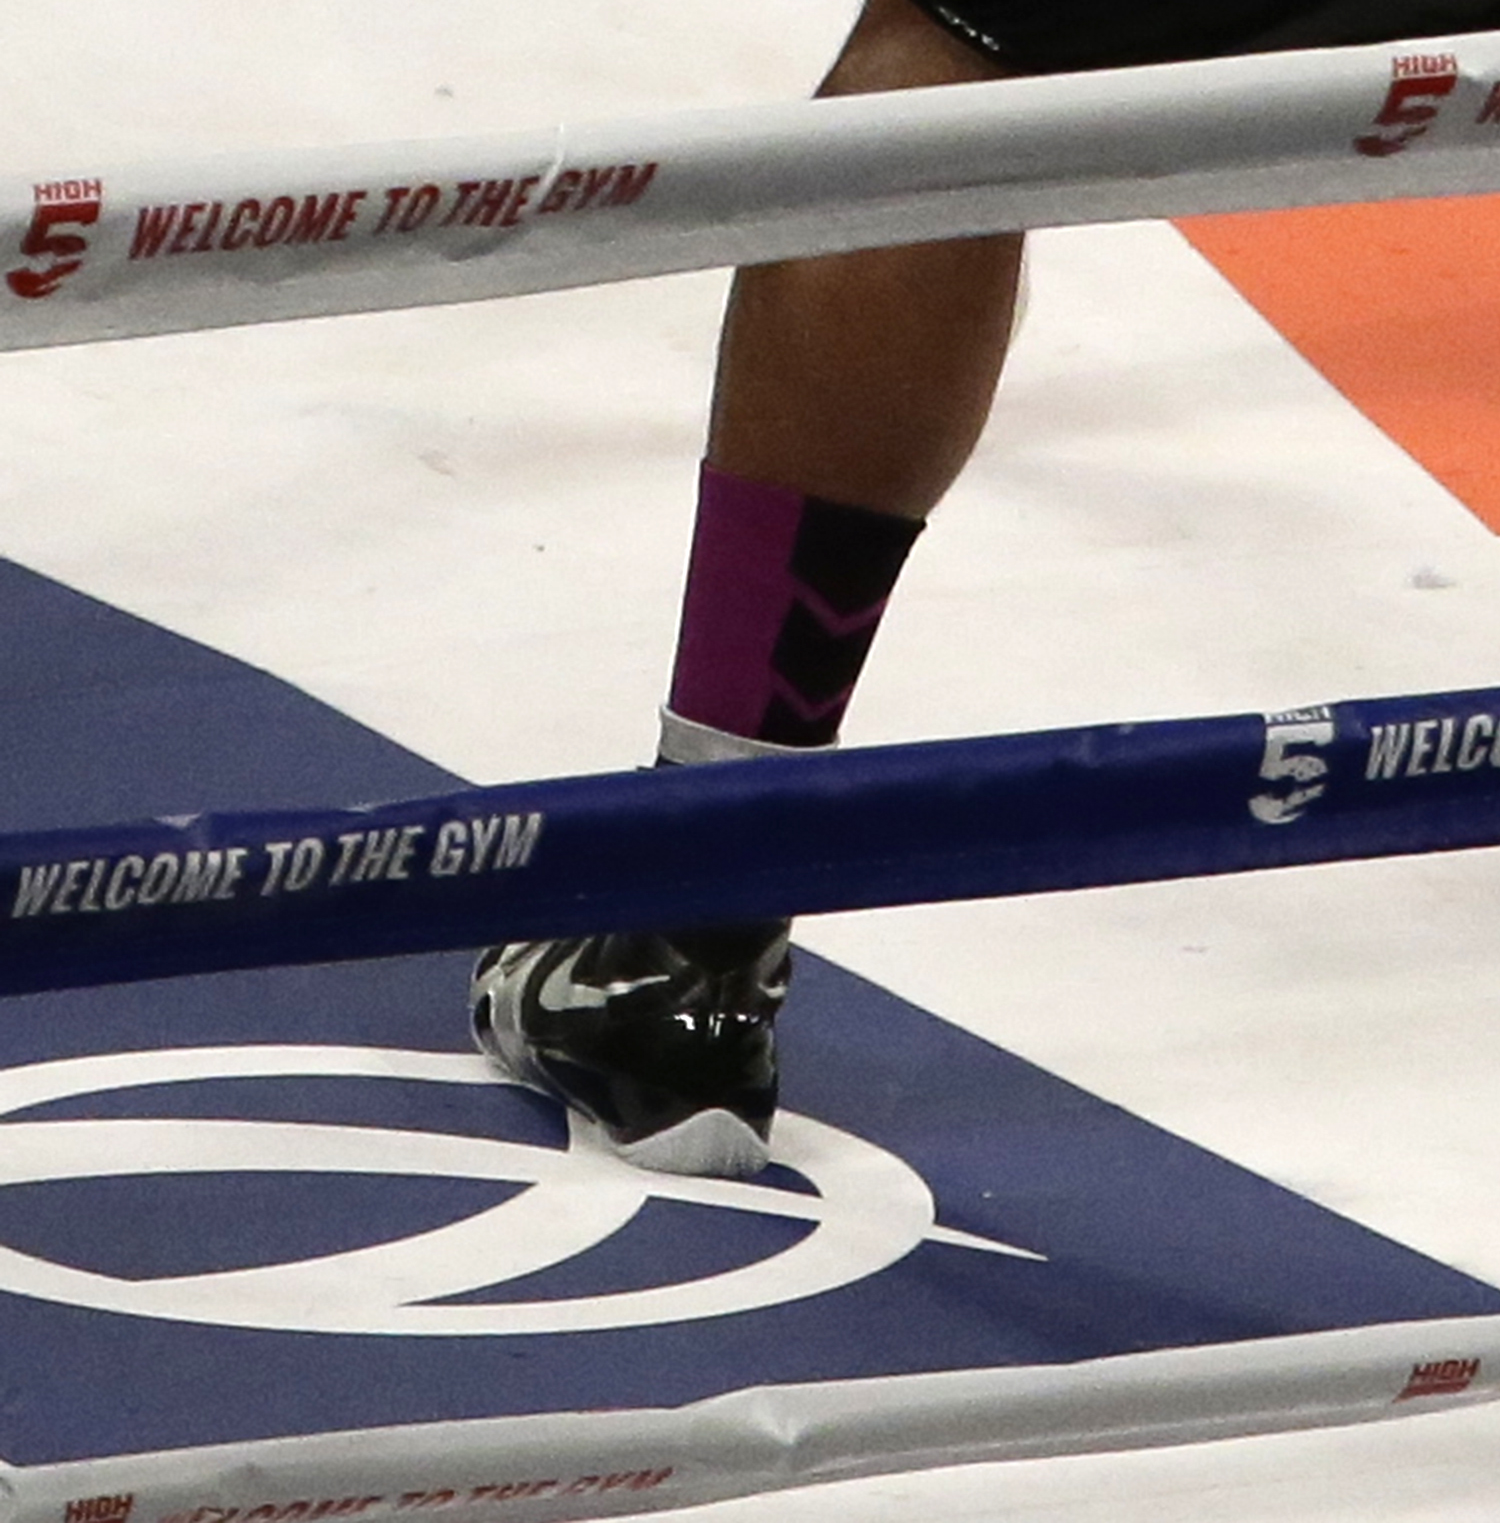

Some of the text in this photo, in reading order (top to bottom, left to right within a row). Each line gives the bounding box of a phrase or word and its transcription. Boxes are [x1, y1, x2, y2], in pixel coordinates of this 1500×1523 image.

[1393, 53, 1459, 77] HIGH
[1353, 74, 1457, 157] 5
[31, 177, 102, 202] HIGH
[128, 162, 659, 260] WELCOME TO THE GYM
[6, 201, 100, 299] 5
[1248, 721, 1335, 825] 5
[12, 812, 546, 919] WELCOME TO THE GYM
[1411, 1358, 1482, 1383] HIGH
[65, 1492, 135, 1523] HIGH
